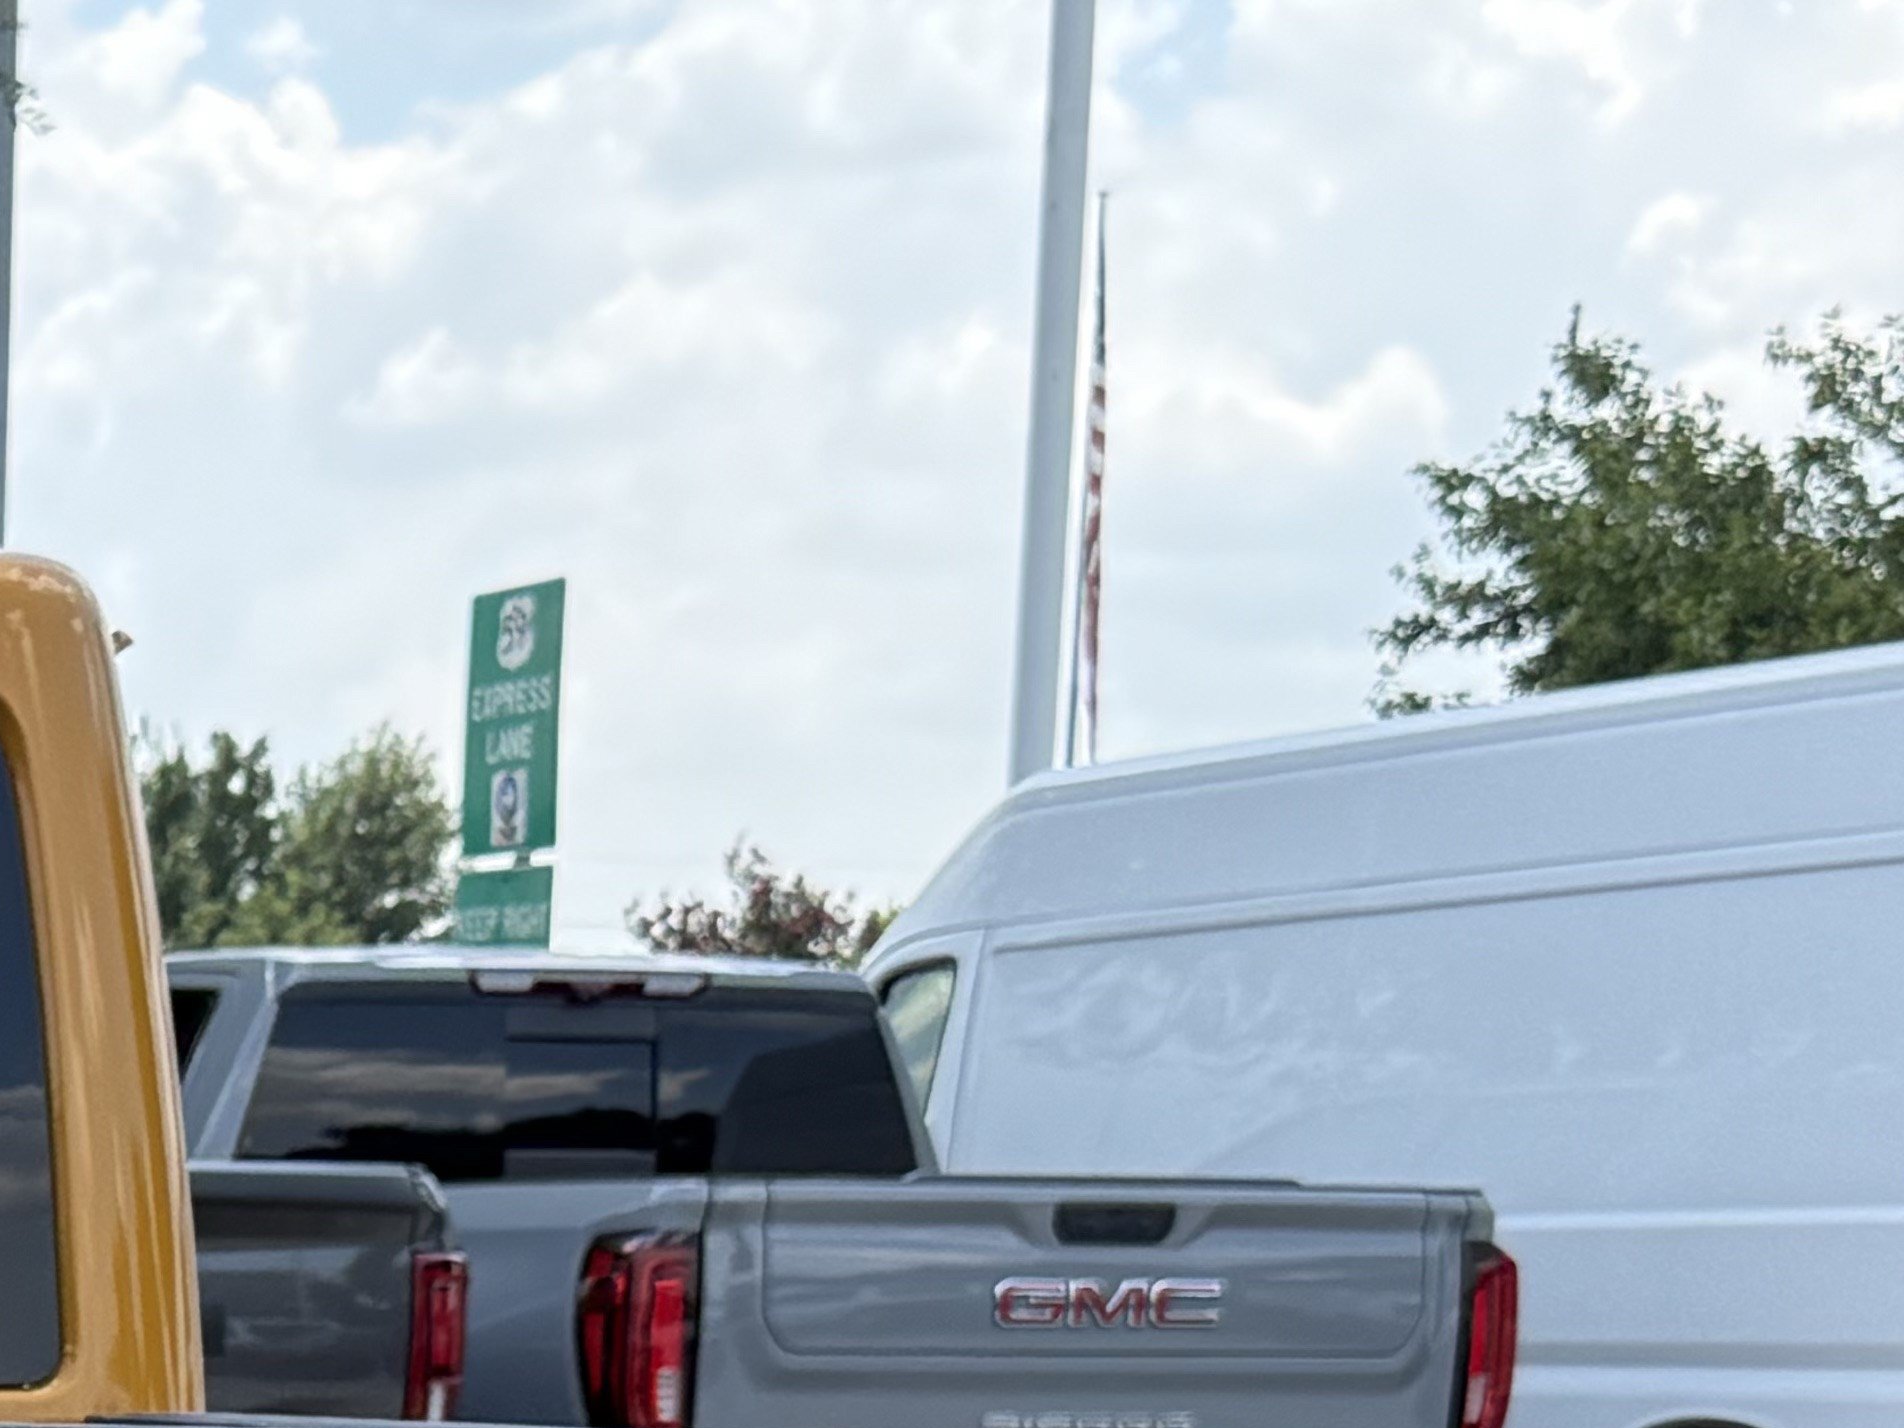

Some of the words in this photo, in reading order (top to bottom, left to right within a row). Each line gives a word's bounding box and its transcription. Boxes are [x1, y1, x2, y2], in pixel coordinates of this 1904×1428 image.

[471, 674, 553, 723] EXPRESS
[485, 724, 534, 766] LANE
[994, 1276, 1226, 1329] GMC
